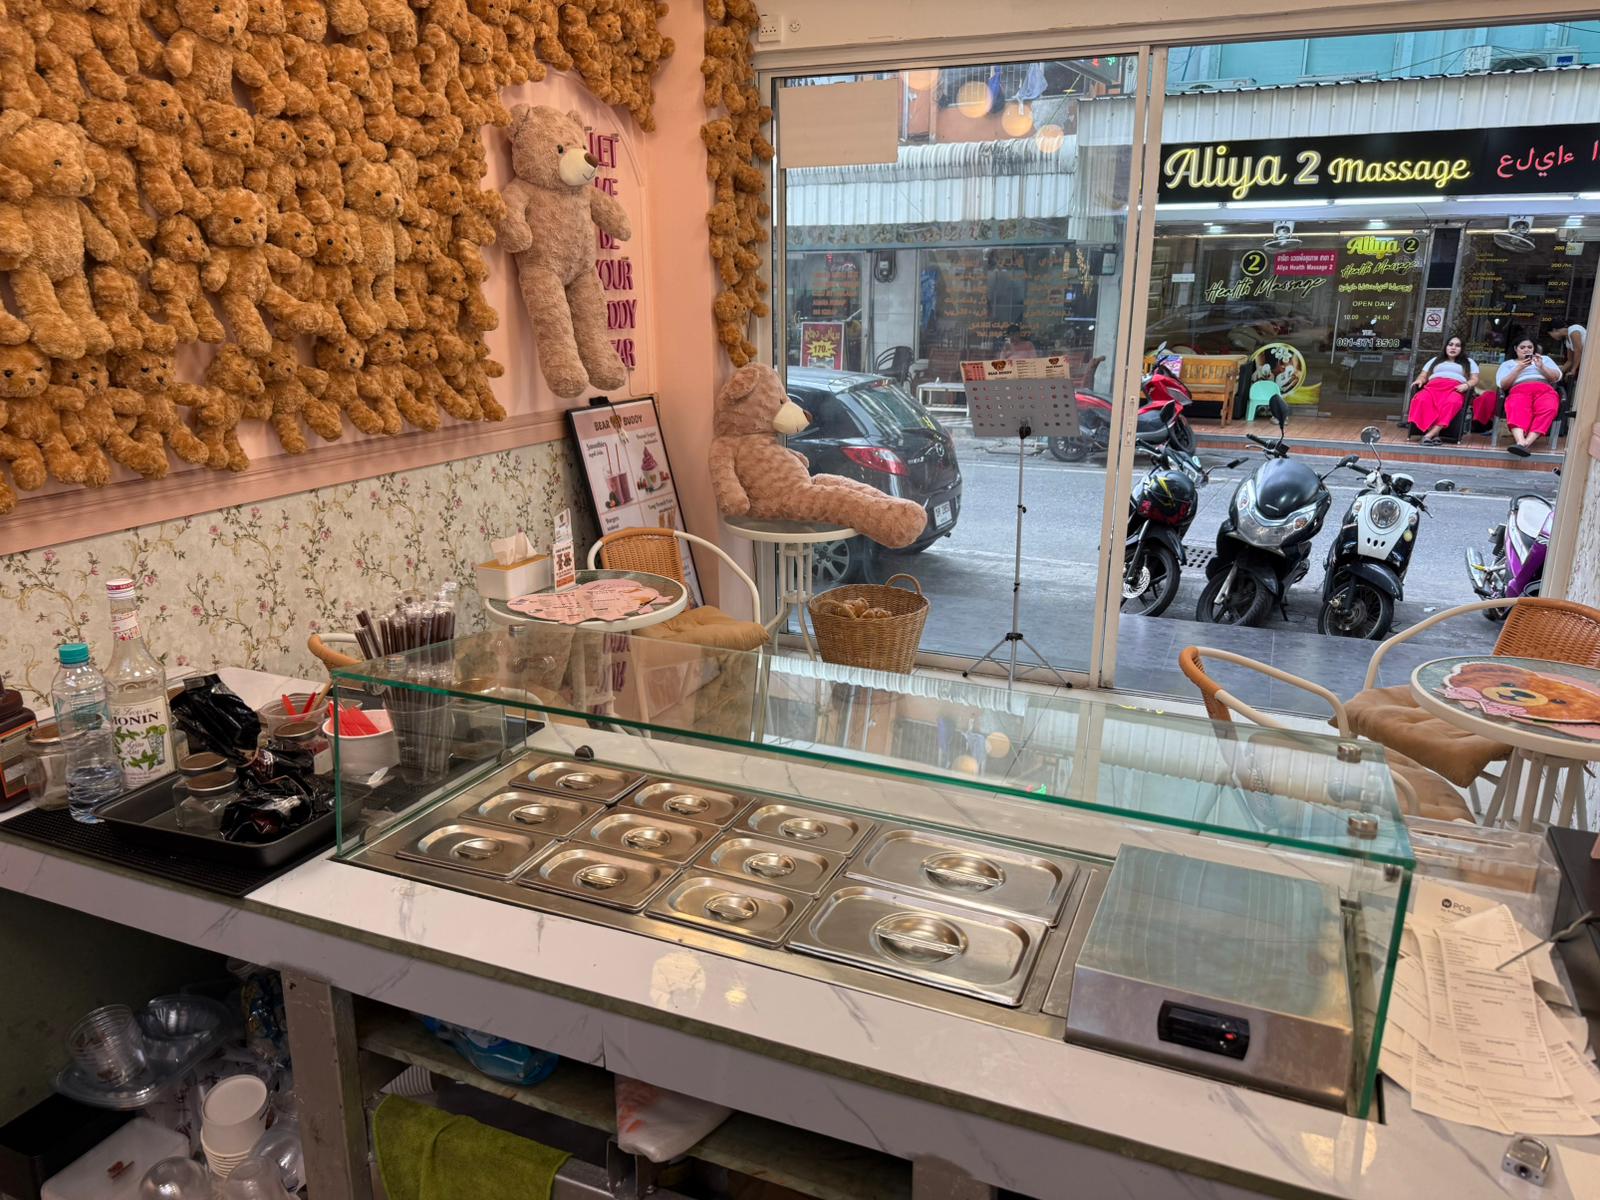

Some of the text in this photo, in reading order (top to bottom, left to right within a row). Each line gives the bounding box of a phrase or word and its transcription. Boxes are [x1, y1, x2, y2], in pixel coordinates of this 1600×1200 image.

[1164, 144, 1287, 200] Aliya
[1293, 150, 1321, 186] 2
[1346, 235, 1401, 259] Aliya
[1247, 254, 1260, 271] 2
[1205, 277, 1254, 303] Health
[1253, 275, 1327, 299] Massage
[594, 414, 643, 431] BEAR BUDDY
[1453, 902, 1472, 914] POS
